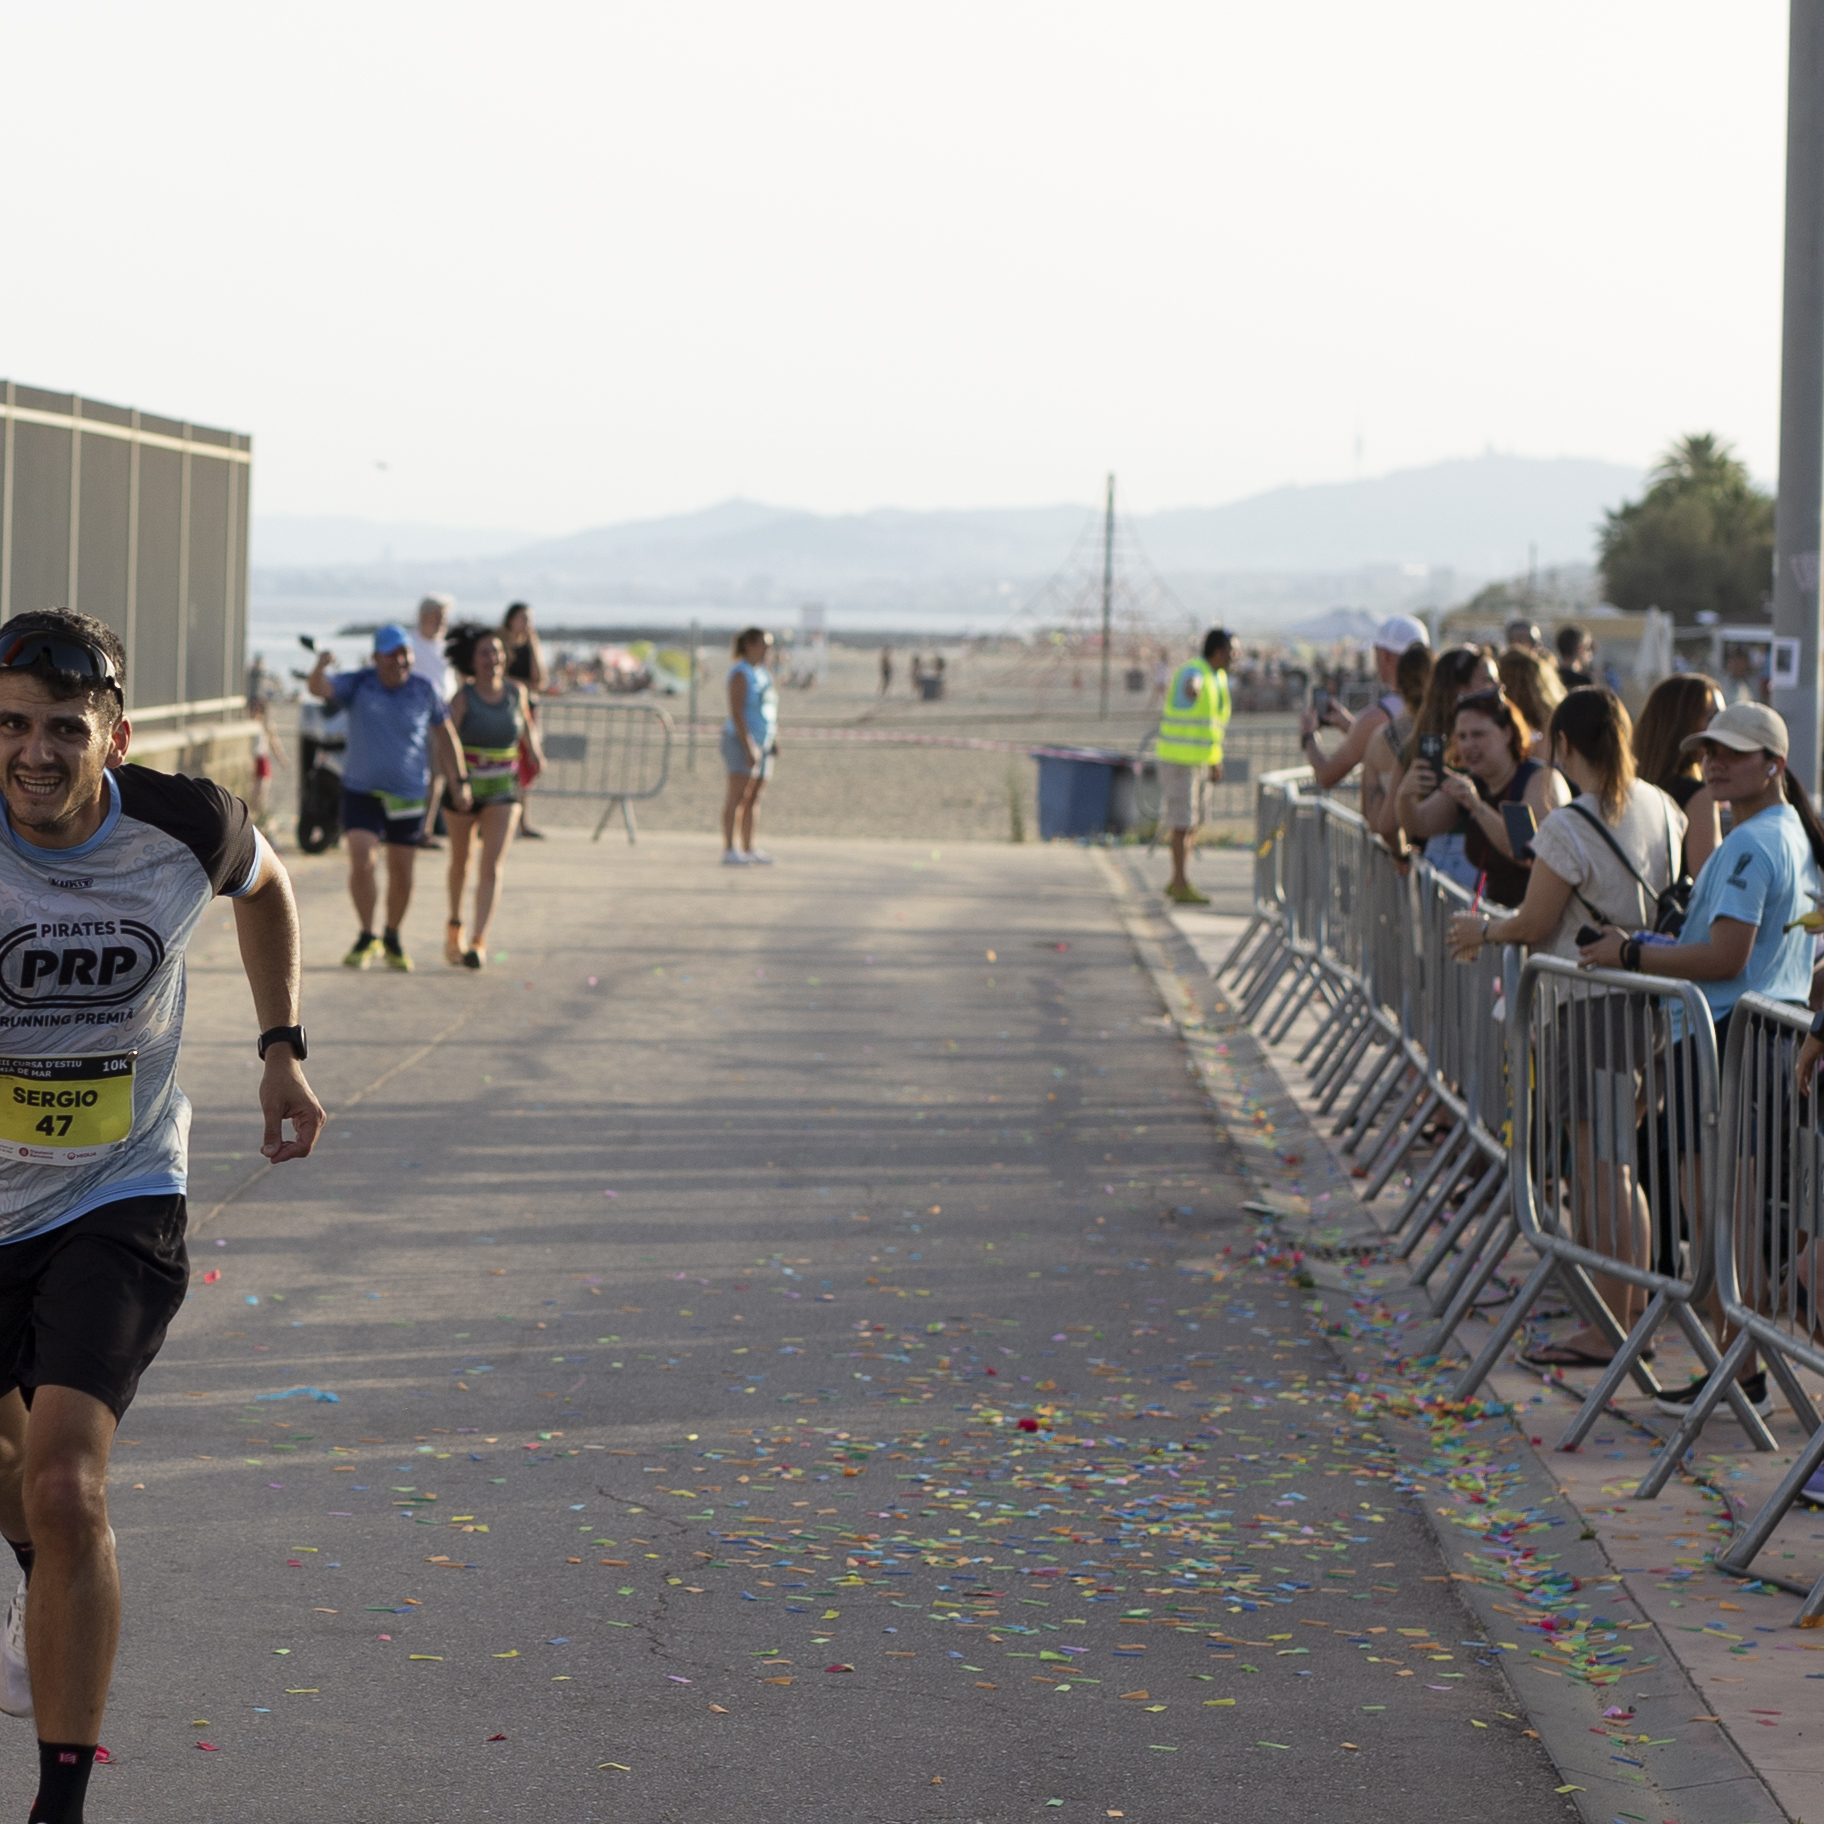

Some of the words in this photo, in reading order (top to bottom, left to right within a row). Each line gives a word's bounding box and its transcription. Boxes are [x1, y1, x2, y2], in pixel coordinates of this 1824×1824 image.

[41, 921, 117, 938] PIRATES
[20, 946, 138, 989] PRP
[0, 1014, 72, 1027] RUNNING
[75, 1007, 134, 1025] PREMIÀ
[12, 1059, 43, 1069] CURSA
[45, 1059, 83, 1069] D'ESTIU
[17, 1067, 29, 1075] DE
[102, 1059, 128, 1072] 10K
[12, 1086, 99, 1108] SERGIO
[35, 1114, 74, 1137] 47
